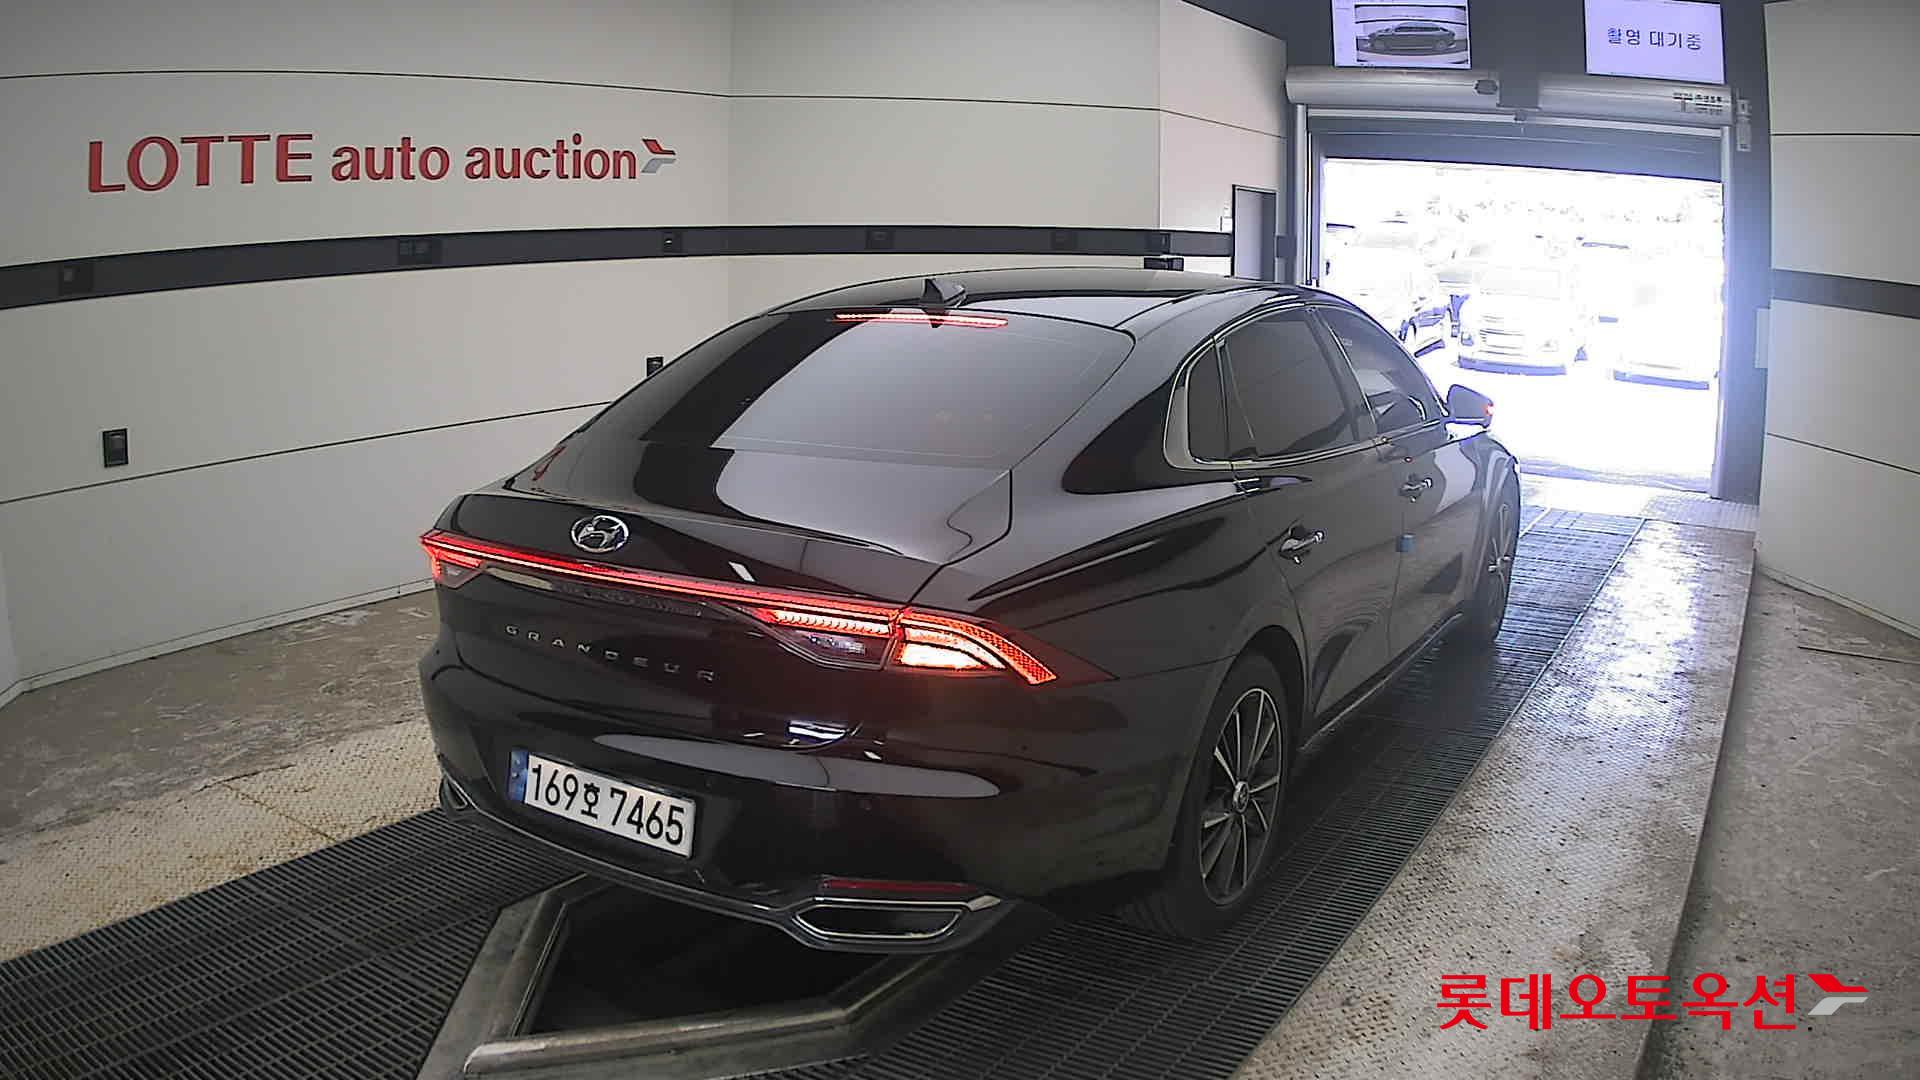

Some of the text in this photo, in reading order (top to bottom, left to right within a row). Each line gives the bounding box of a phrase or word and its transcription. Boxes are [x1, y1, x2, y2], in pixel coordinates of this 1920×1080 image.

[1608, 27, 1701, 50] 촬영 대기중
[88, 133, 637, 193] LOTTE auto auction
[505, 624, 715, 682] GRANDEUR
[609, 787, 686, 846] 7465
